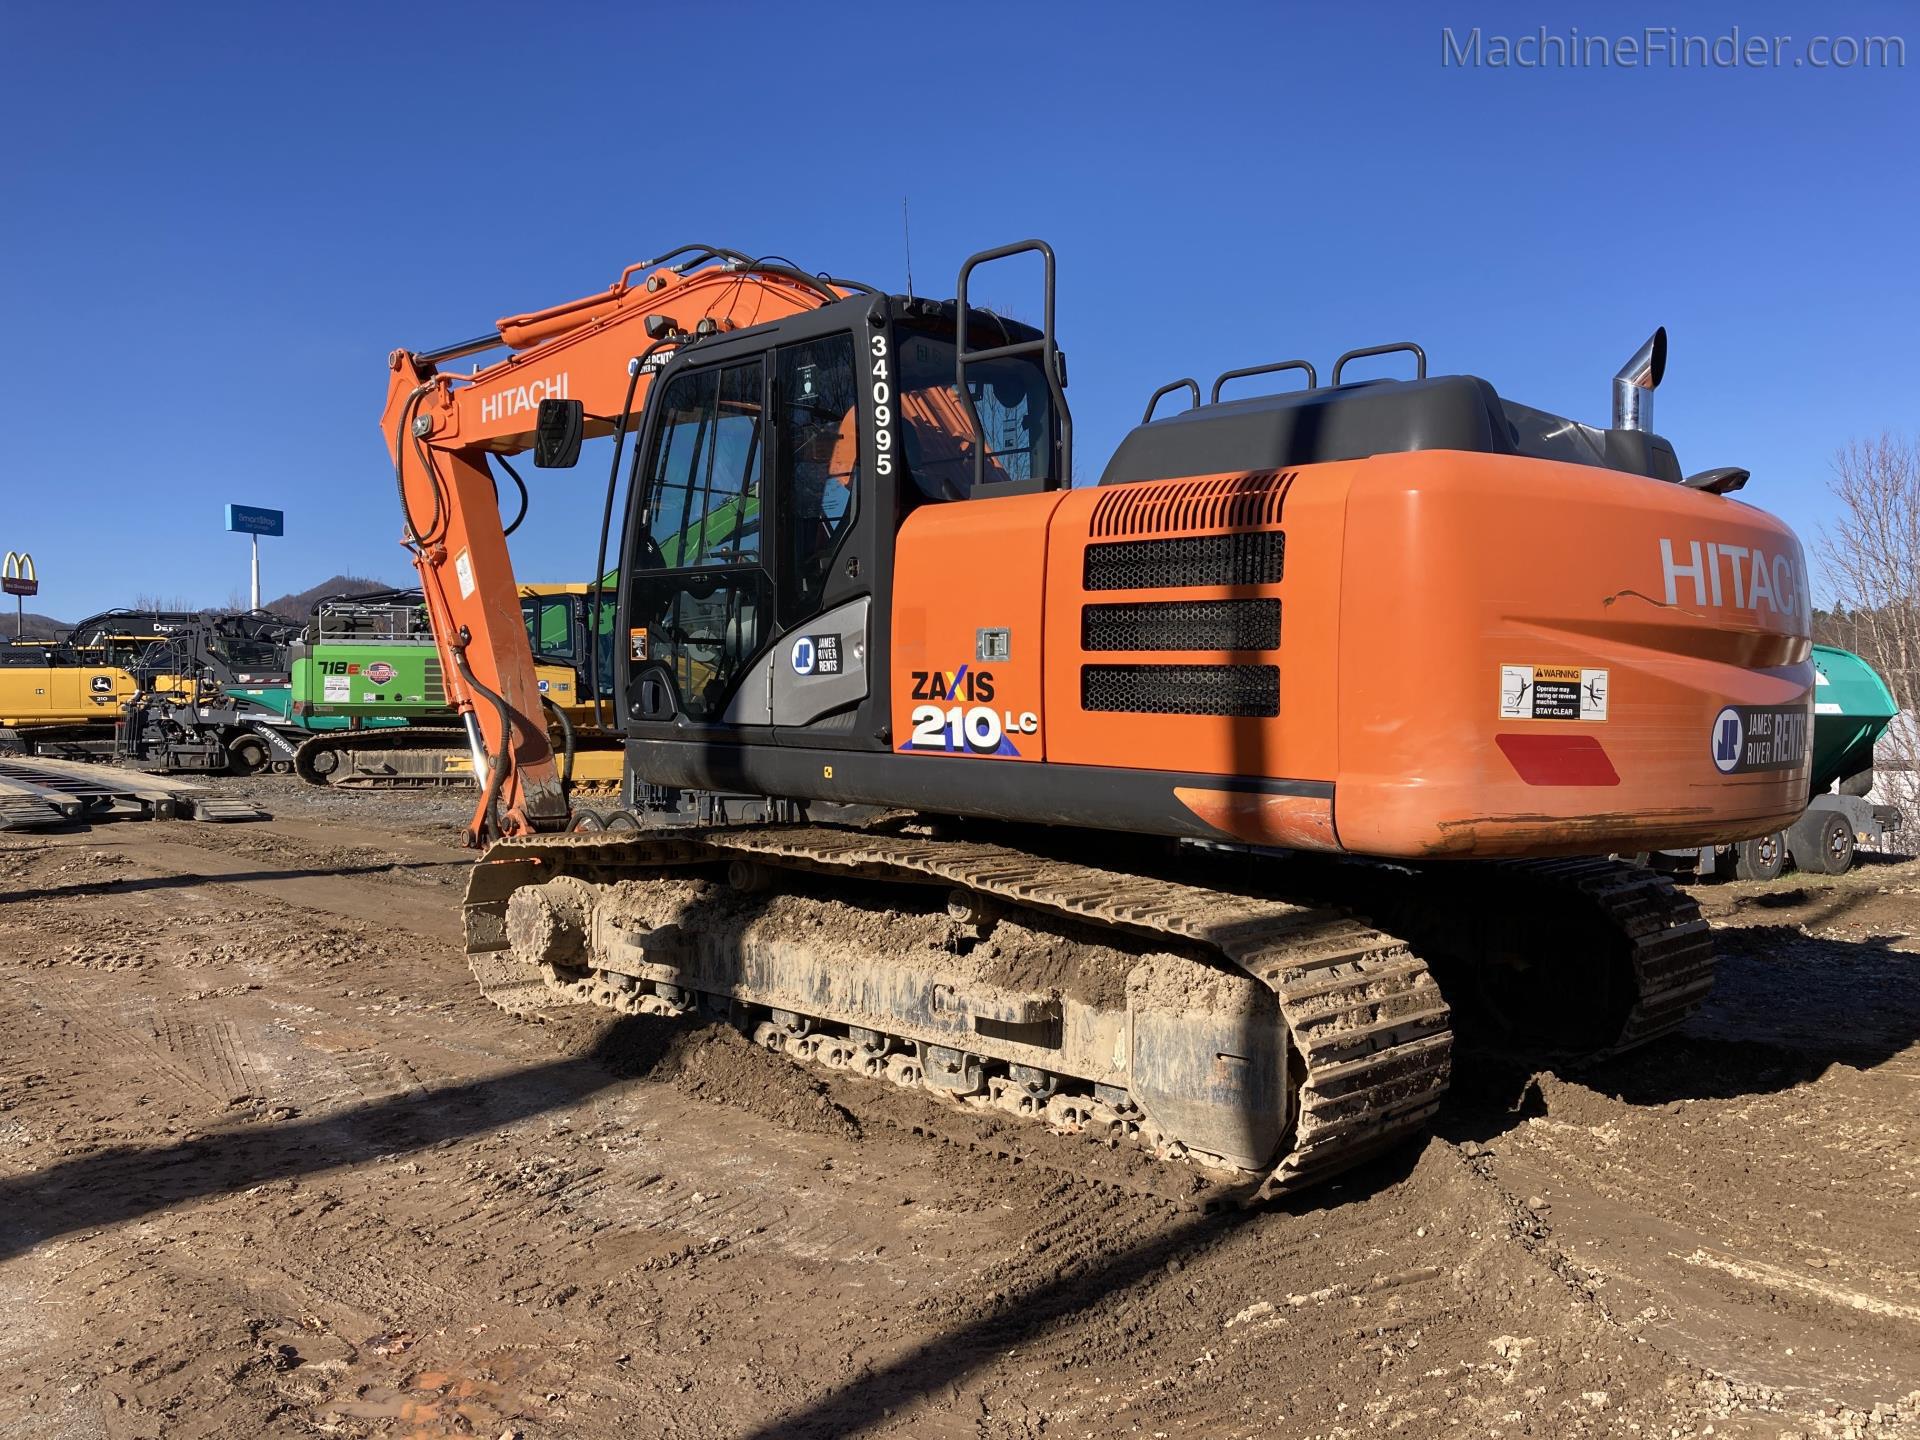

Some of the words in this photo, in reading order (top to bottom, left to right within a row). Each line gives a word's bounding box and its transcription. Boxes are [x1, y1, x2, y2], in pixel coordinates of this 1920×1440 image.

[482, 371, 568, 423] HITACHI
[871, 335, 892, 475] 340995
[1659, 538, 1807, 616] HITACH
[817, 648, 838, 660] RIVER
[818, 637, 836, 648] JAMES
[818, 659, 838, 672] RENTS
[1543, 670, 1579, 679] WARNING
[911, 664, 995, 702] ZAXIS
[911, 704, 1002, 754] 210
[1004, 710, 1038, 735] LC
[1748, 713, 1772, 735] JAMES
[1773, 713, 1806, 762] RENTS
[1746, 741, 1771, 765] RIVER
